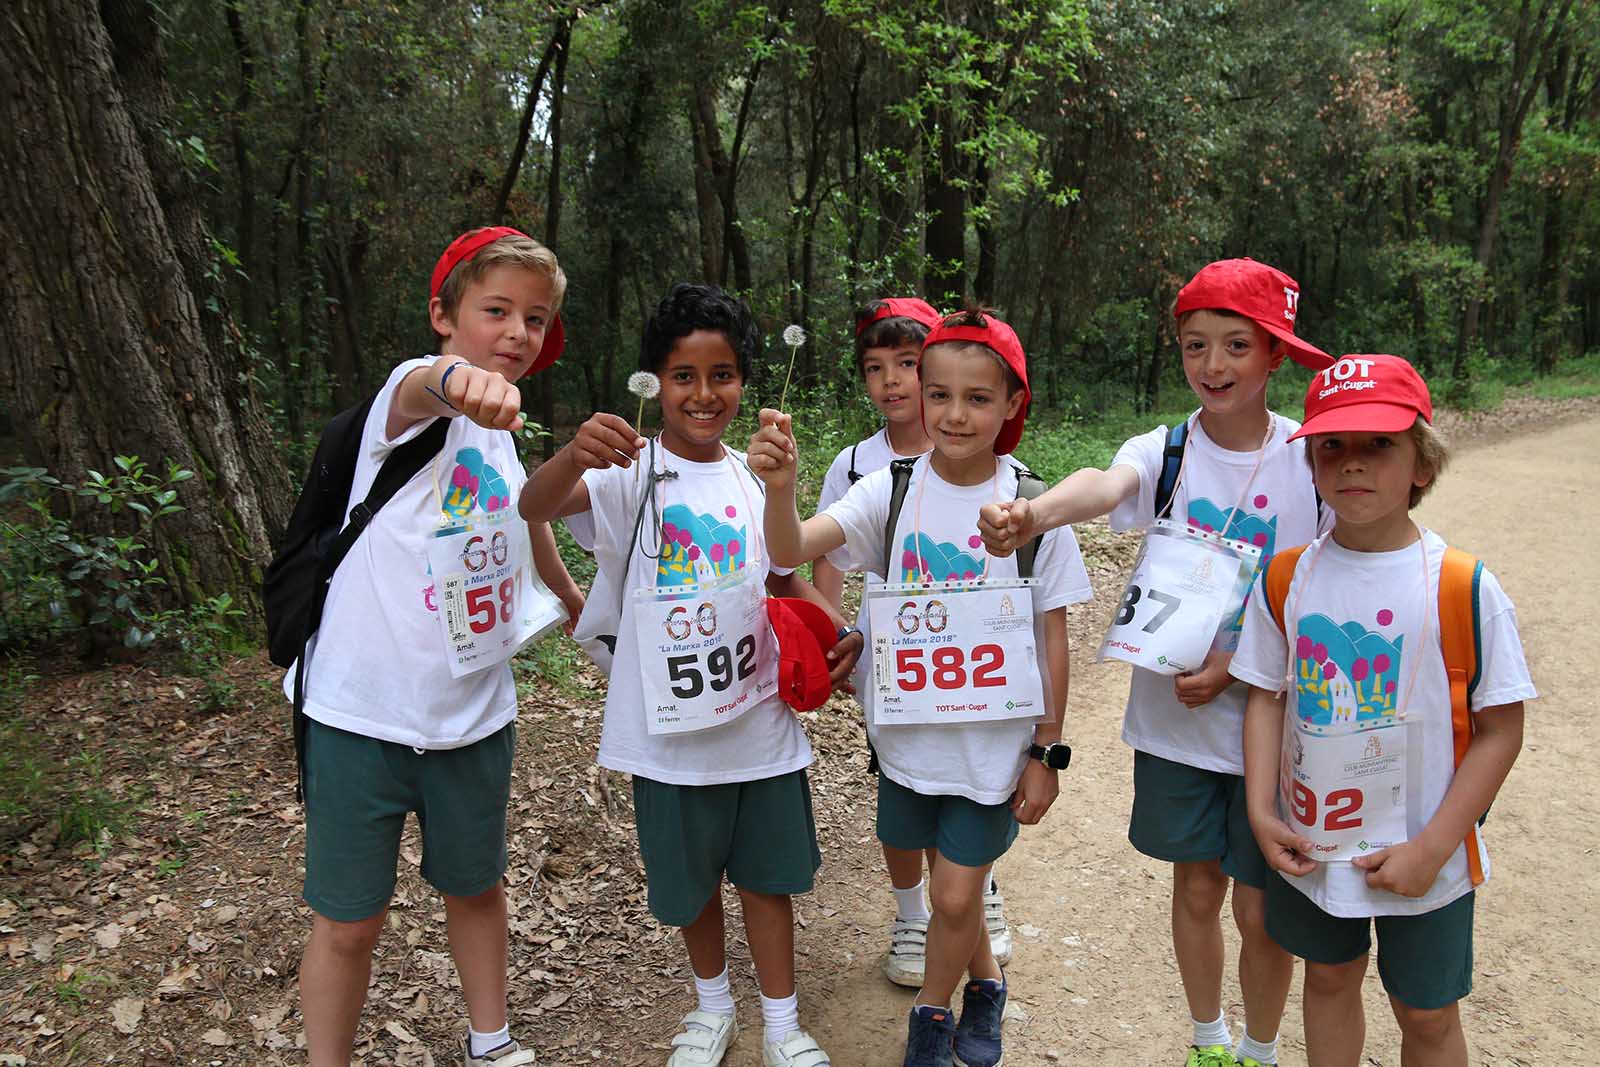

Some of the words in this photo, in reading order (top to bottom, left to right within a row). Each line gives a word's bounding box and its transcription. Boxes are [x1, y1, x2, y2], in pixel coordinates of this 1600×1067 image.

[1322, 359, 1376, 387] TOT
[1318, 385, 1338, 400] Sant
[1343, 380, 1377, 391] Cugat
[463, 531, 507, 573] 60
[471, 573, 495, 585] Marxa
[666, 602, 717, 641] 60
[896, 600, 948, 635] 60
[673, 643, 701, 652] Marxa
[902, 636, 928, 645] Marxa
[1122, 642, 1141, 654] Cugat
[667, 634, 757, 699] 592
[896, 643, 1007, 692] 582
[657, 704, 678, 712] Amat.
[935, 703, 951, 712] TOT
[950, 703, 966, 712] Sant
[968, 702, 988, 712] Cugat
[1315, 844, 1338, 853] Cugat
